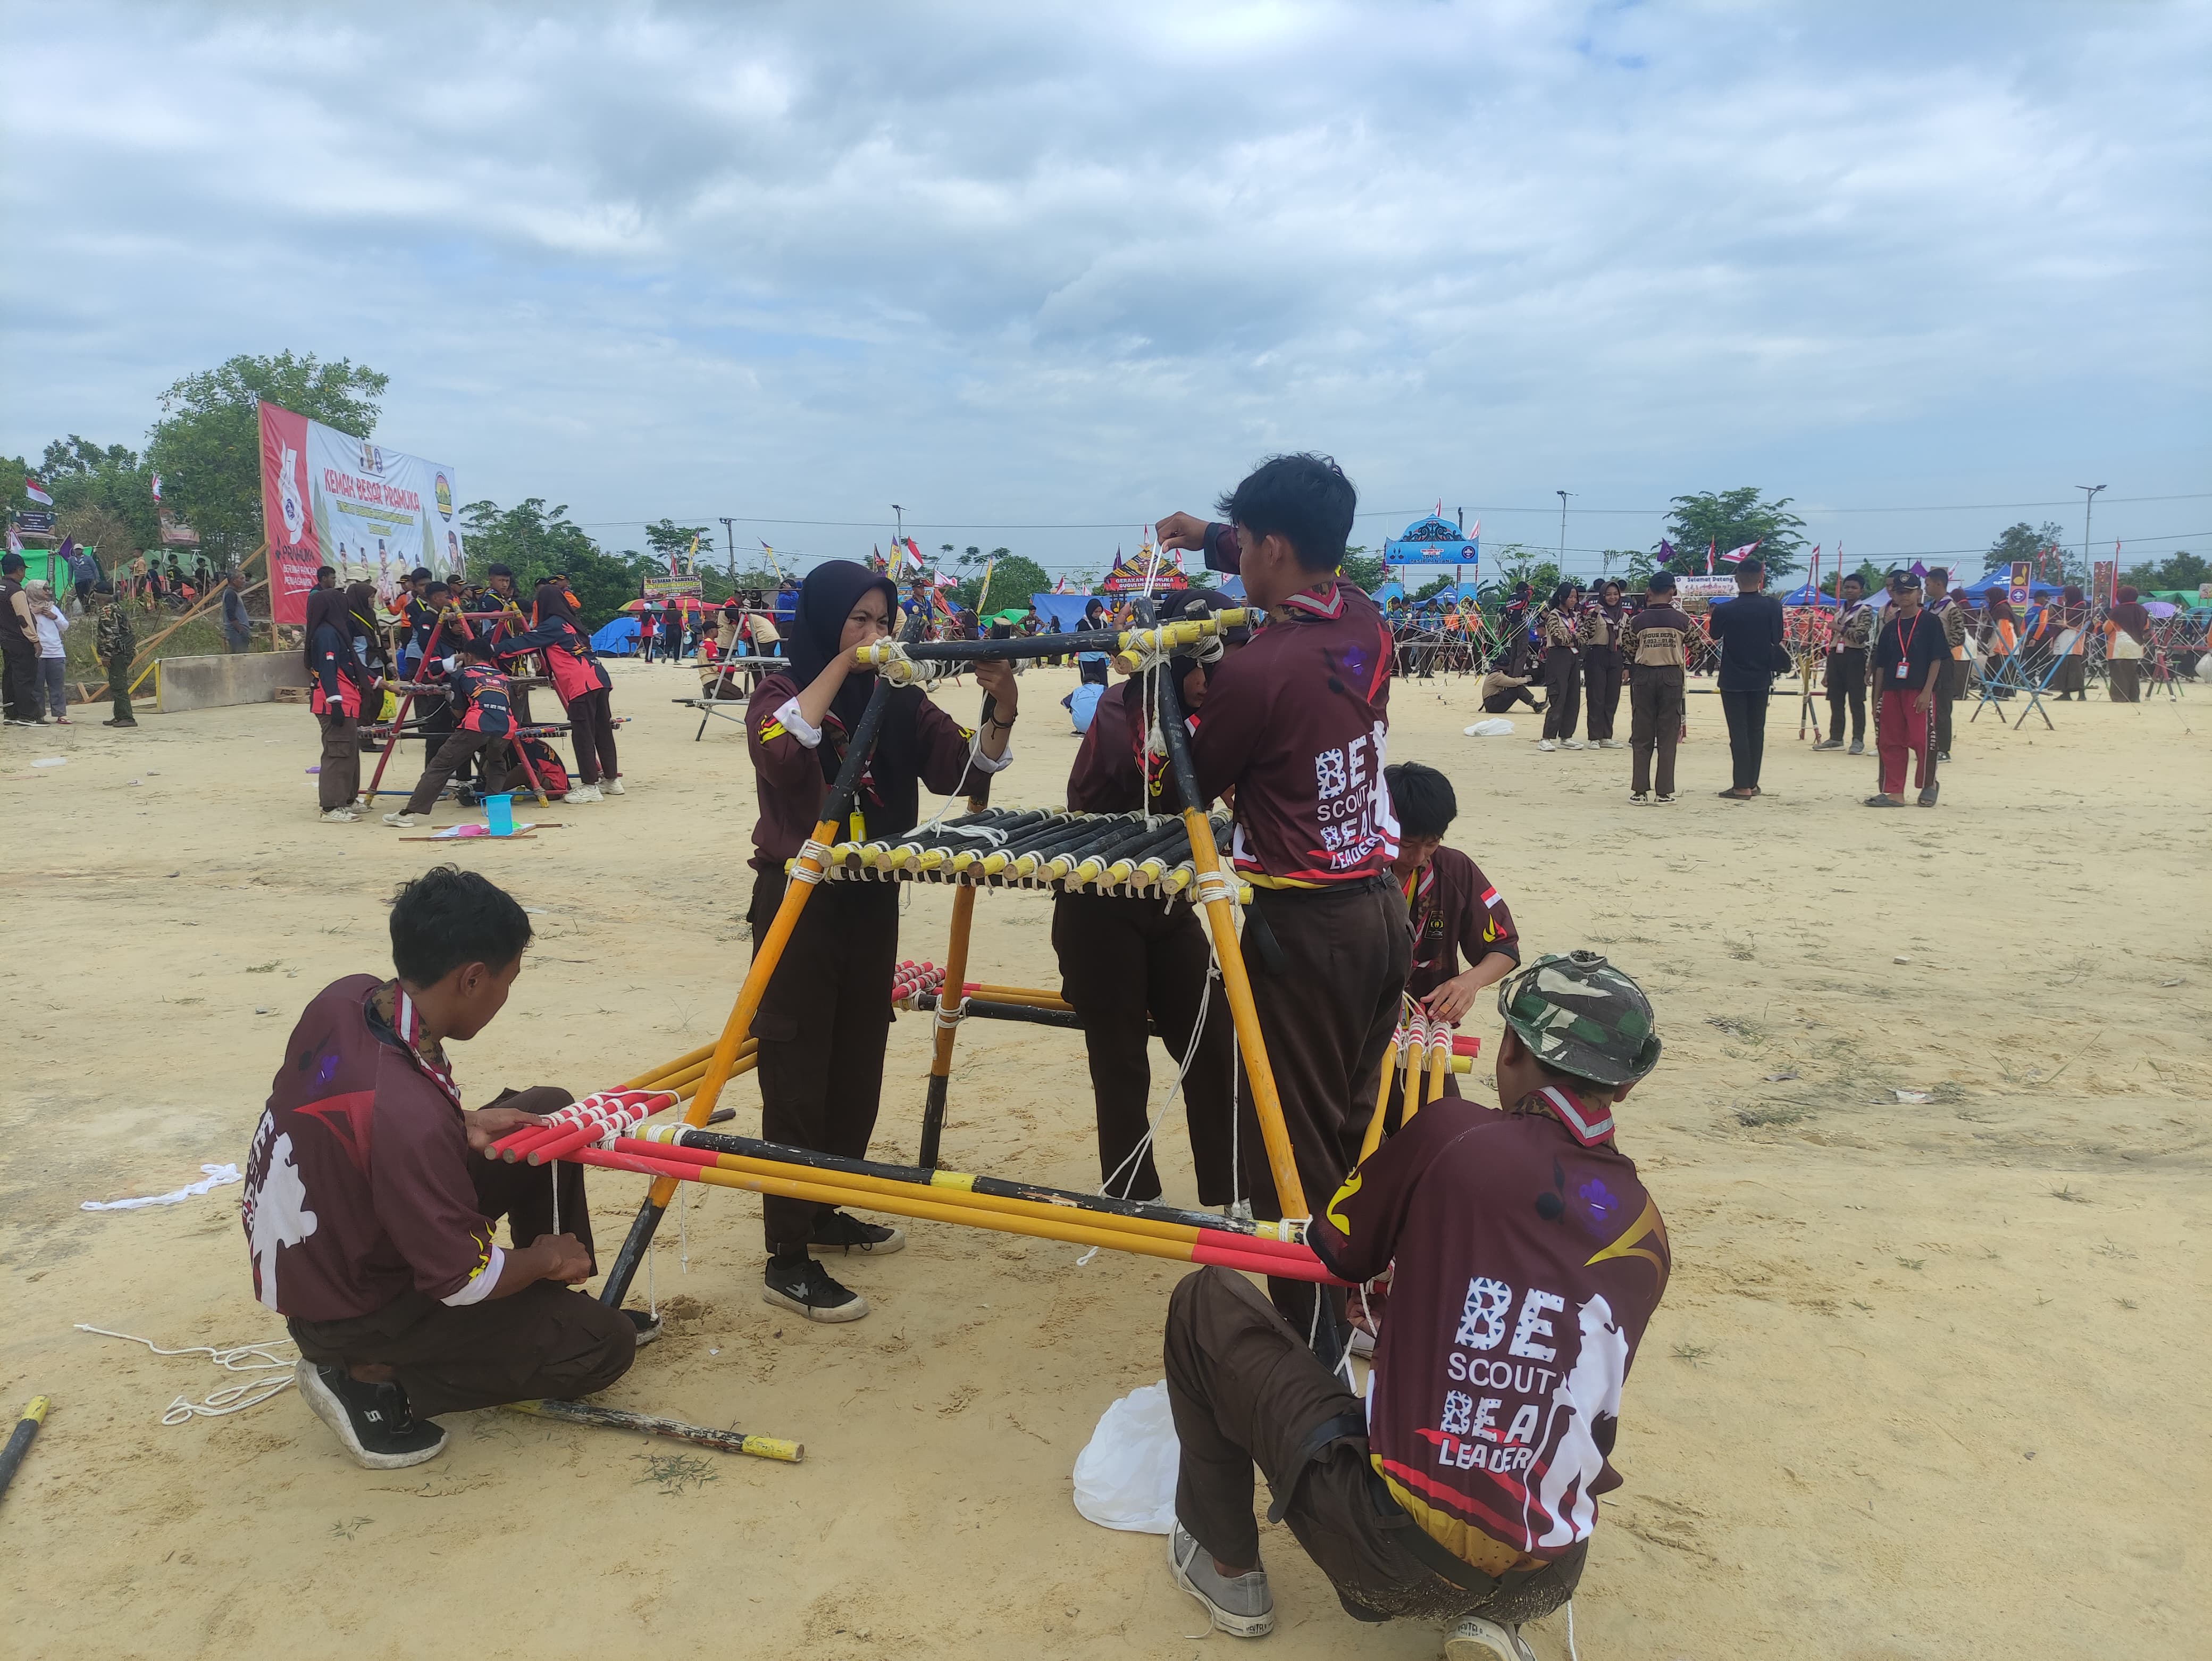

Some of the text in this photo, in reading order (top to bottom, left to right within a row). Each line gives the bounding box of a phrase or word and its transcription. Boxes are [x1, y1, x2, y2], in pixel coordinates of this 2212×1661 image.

[324, 468, 356, 498] KEMAH
[356, 478, 383, 505] BESAR
[383, 485, 420, 512] PRAMUKA
[282, 545, 315, 562] PRAMUKA
[1315, 734, 1367, 800] BE
[1317, 784, 1368, 822] SCOUT
[1320, 810, 1368, 852] BE A
[1330, 837, 1380, 870] LEADER
[253, 1108, 275, 1164] E
[1454, 1277, 1565, 1363] BE
[1447, 1352, 1557, 1395] SCOUT
[1440, 1389, 1539, 1444] BE A
[1438, 1439, 1534, 1473] LEADER
